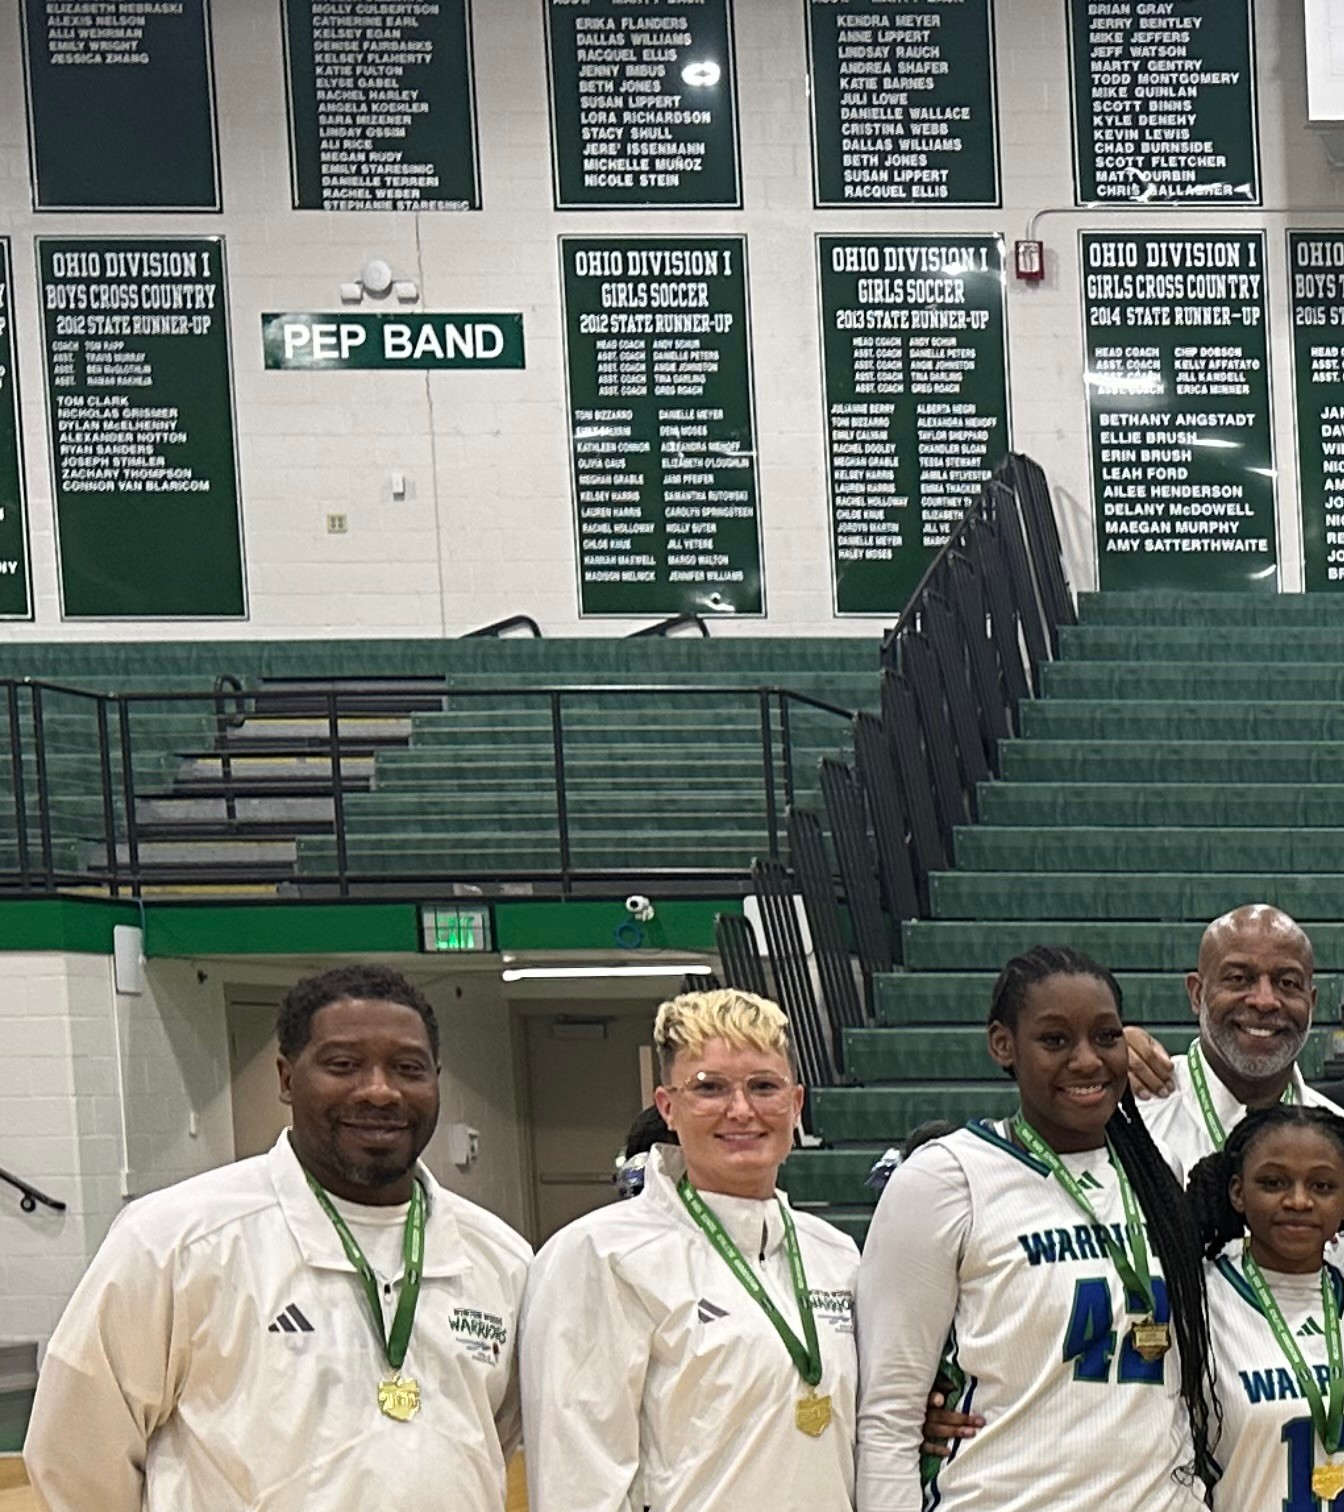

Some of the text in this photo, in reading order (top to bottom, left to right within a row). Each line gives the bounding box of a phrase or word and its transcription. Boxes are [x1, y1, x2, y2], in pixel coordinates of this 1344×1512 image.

[581, 111, 711, 124] LORA RICHARDSON
[841, 107, 970, 120] DANIELLE WALLACE
[1096, 156, 1226, 168] SCOTT FLETCHER
[845, 185, 948, 198] RACQUEL ELLIS
[53, 252, 210, 277] OHIO DIVISION I
[576, 251, 731, 276] OHIO DIVISION I
[1090, 242, 1256, 267] OHIO DIVISION I
[1298, 242, 1344, 266] OHIO
[46, 284, 216, 310] BOYS CROSS COUNTRY
[602, 283, 707, 308] GIRLS SOCCER
[1087, 274, 1260, 300] GIRLS CROSS COUNTRY
[1295, 274, 1336, 298] BOYS
[57, 315, 211, 335] 2012 STATE RUNNER-UP
[836, 309, 989, 329] 2013 STATE RUNNER-UP
[1091, 306, 1260, 325] 2014 STATE RUNNER-UP
[1296, 307, 1326, 325] 2015
[284, 324, 503, 360] PEP BAND
[1100, 413, 1255, 426] BETHANY ANGSTADT
[1105, 503, 1254, 516] DELANY McDOWELL
[1063, 1276, 1170, 1385] 42
